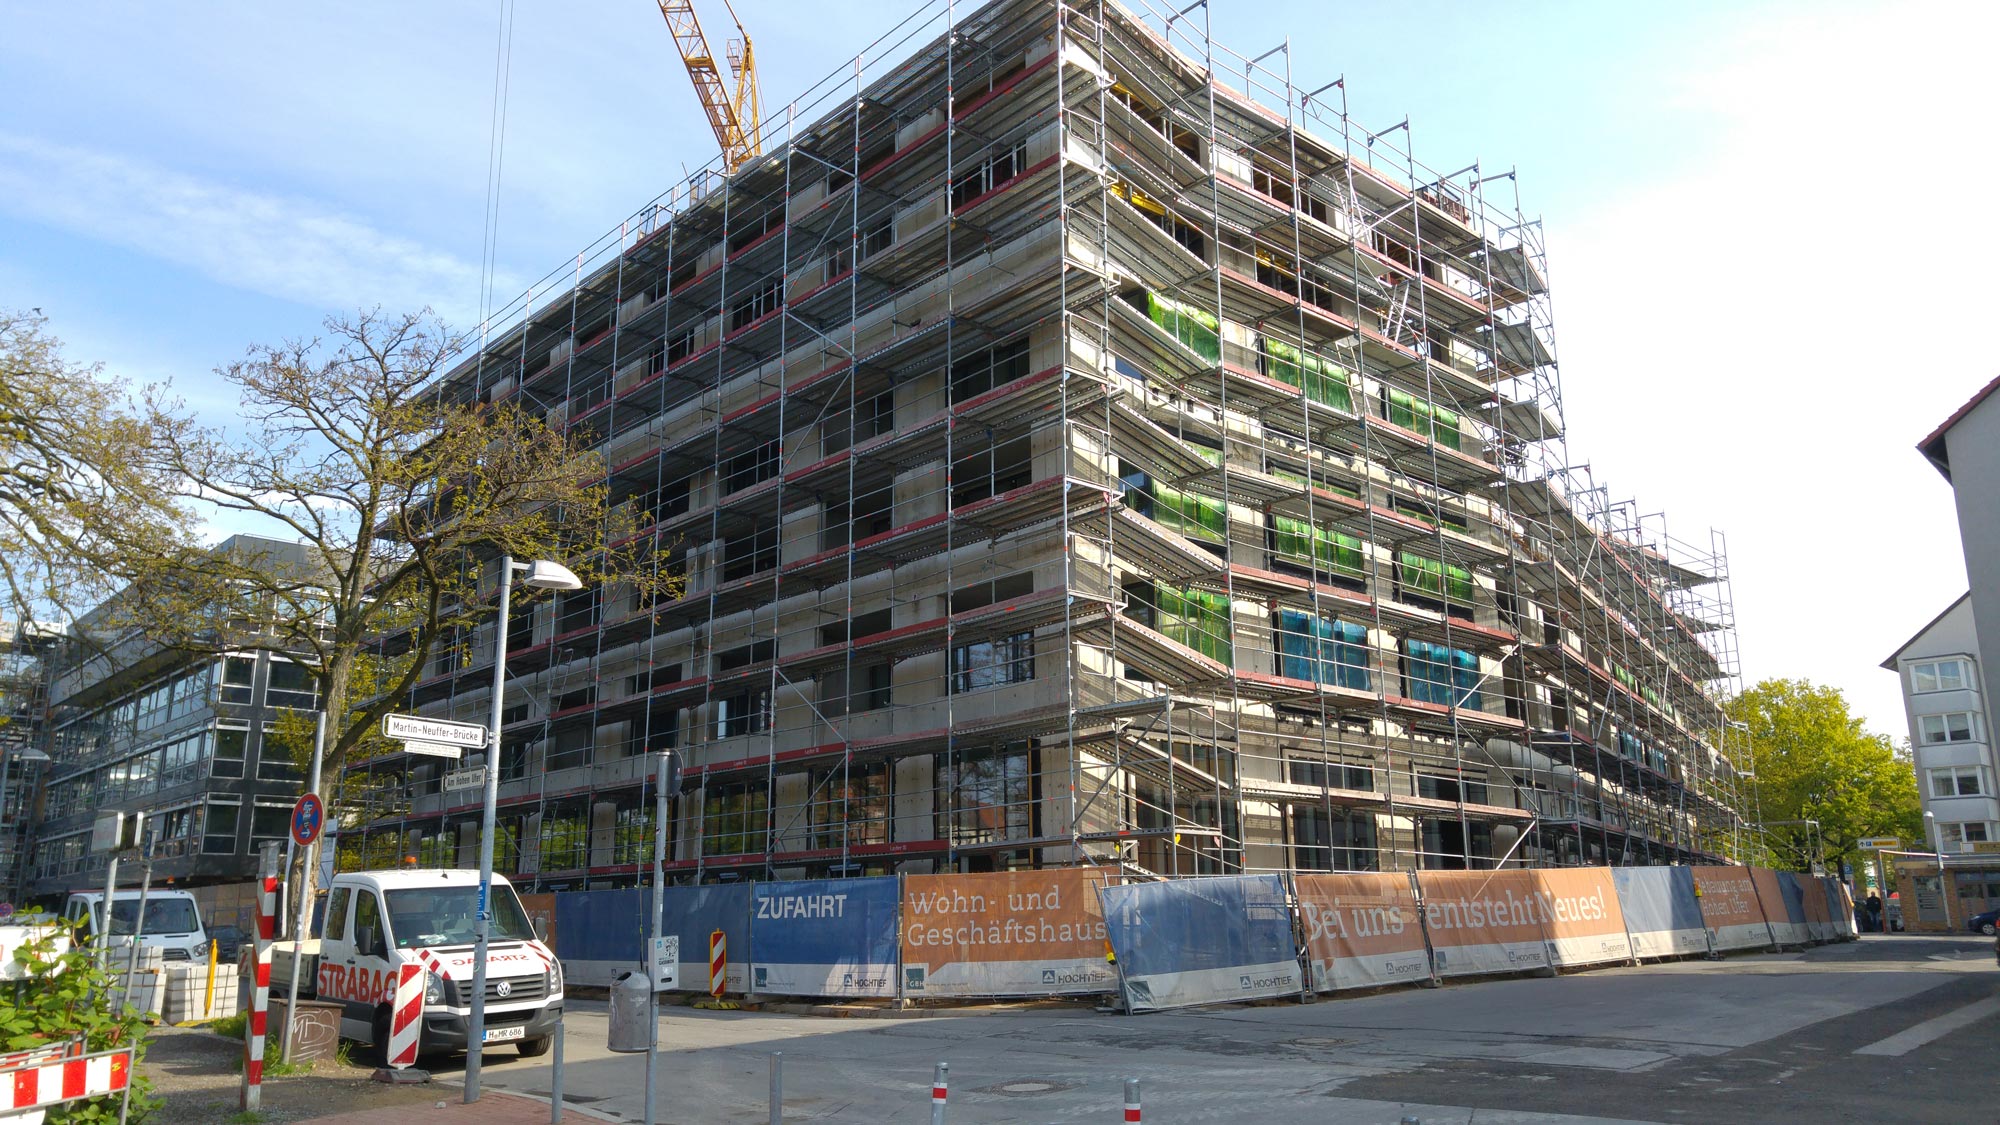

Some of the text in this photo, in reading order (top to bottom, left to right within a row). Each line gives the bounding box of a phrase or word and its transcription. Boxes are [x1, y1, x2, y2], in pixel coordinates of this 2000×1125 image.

[393, 721, 478, 741] Martin-Neuffer-Brücke
[757, 894, 847, 919] ZUFAHRT
[909, 884, 1061, 914] Wohn- und
[1302, 885, 1607, 941] Bei uns entsteht Neues!
[907, 917, 1107, 947] Geschäftshaus
[318, 962, 398, 1007] STRABAG
[854, 978, 887, 988] HOCHTIEF
[1058, 972, 1105, 984] HOCHTIEF
[1253, 975, 1292, 988] HOCHTIEF
[509, 1028, 522, 1036] 686
